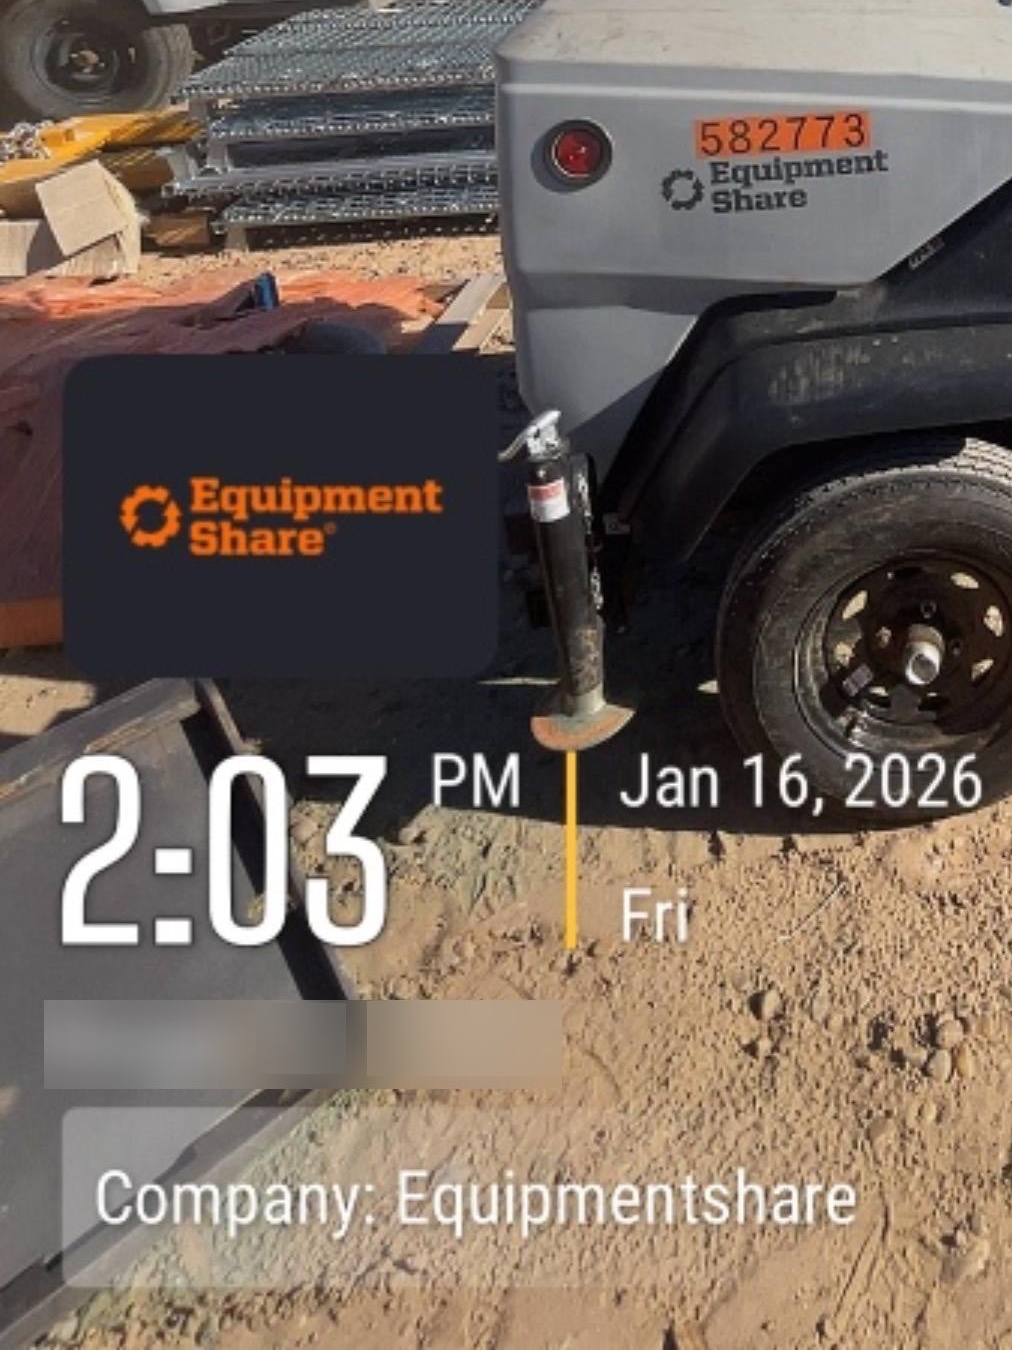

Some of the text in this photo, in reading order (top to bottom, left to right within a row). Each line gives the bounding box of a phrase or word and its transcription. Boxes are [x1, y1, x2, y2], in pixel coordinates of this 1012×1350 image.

[700, 113, 867, 157] 582773
[710, 149, 889, 187] Equipment
[711, 189, 808, 214] Share
